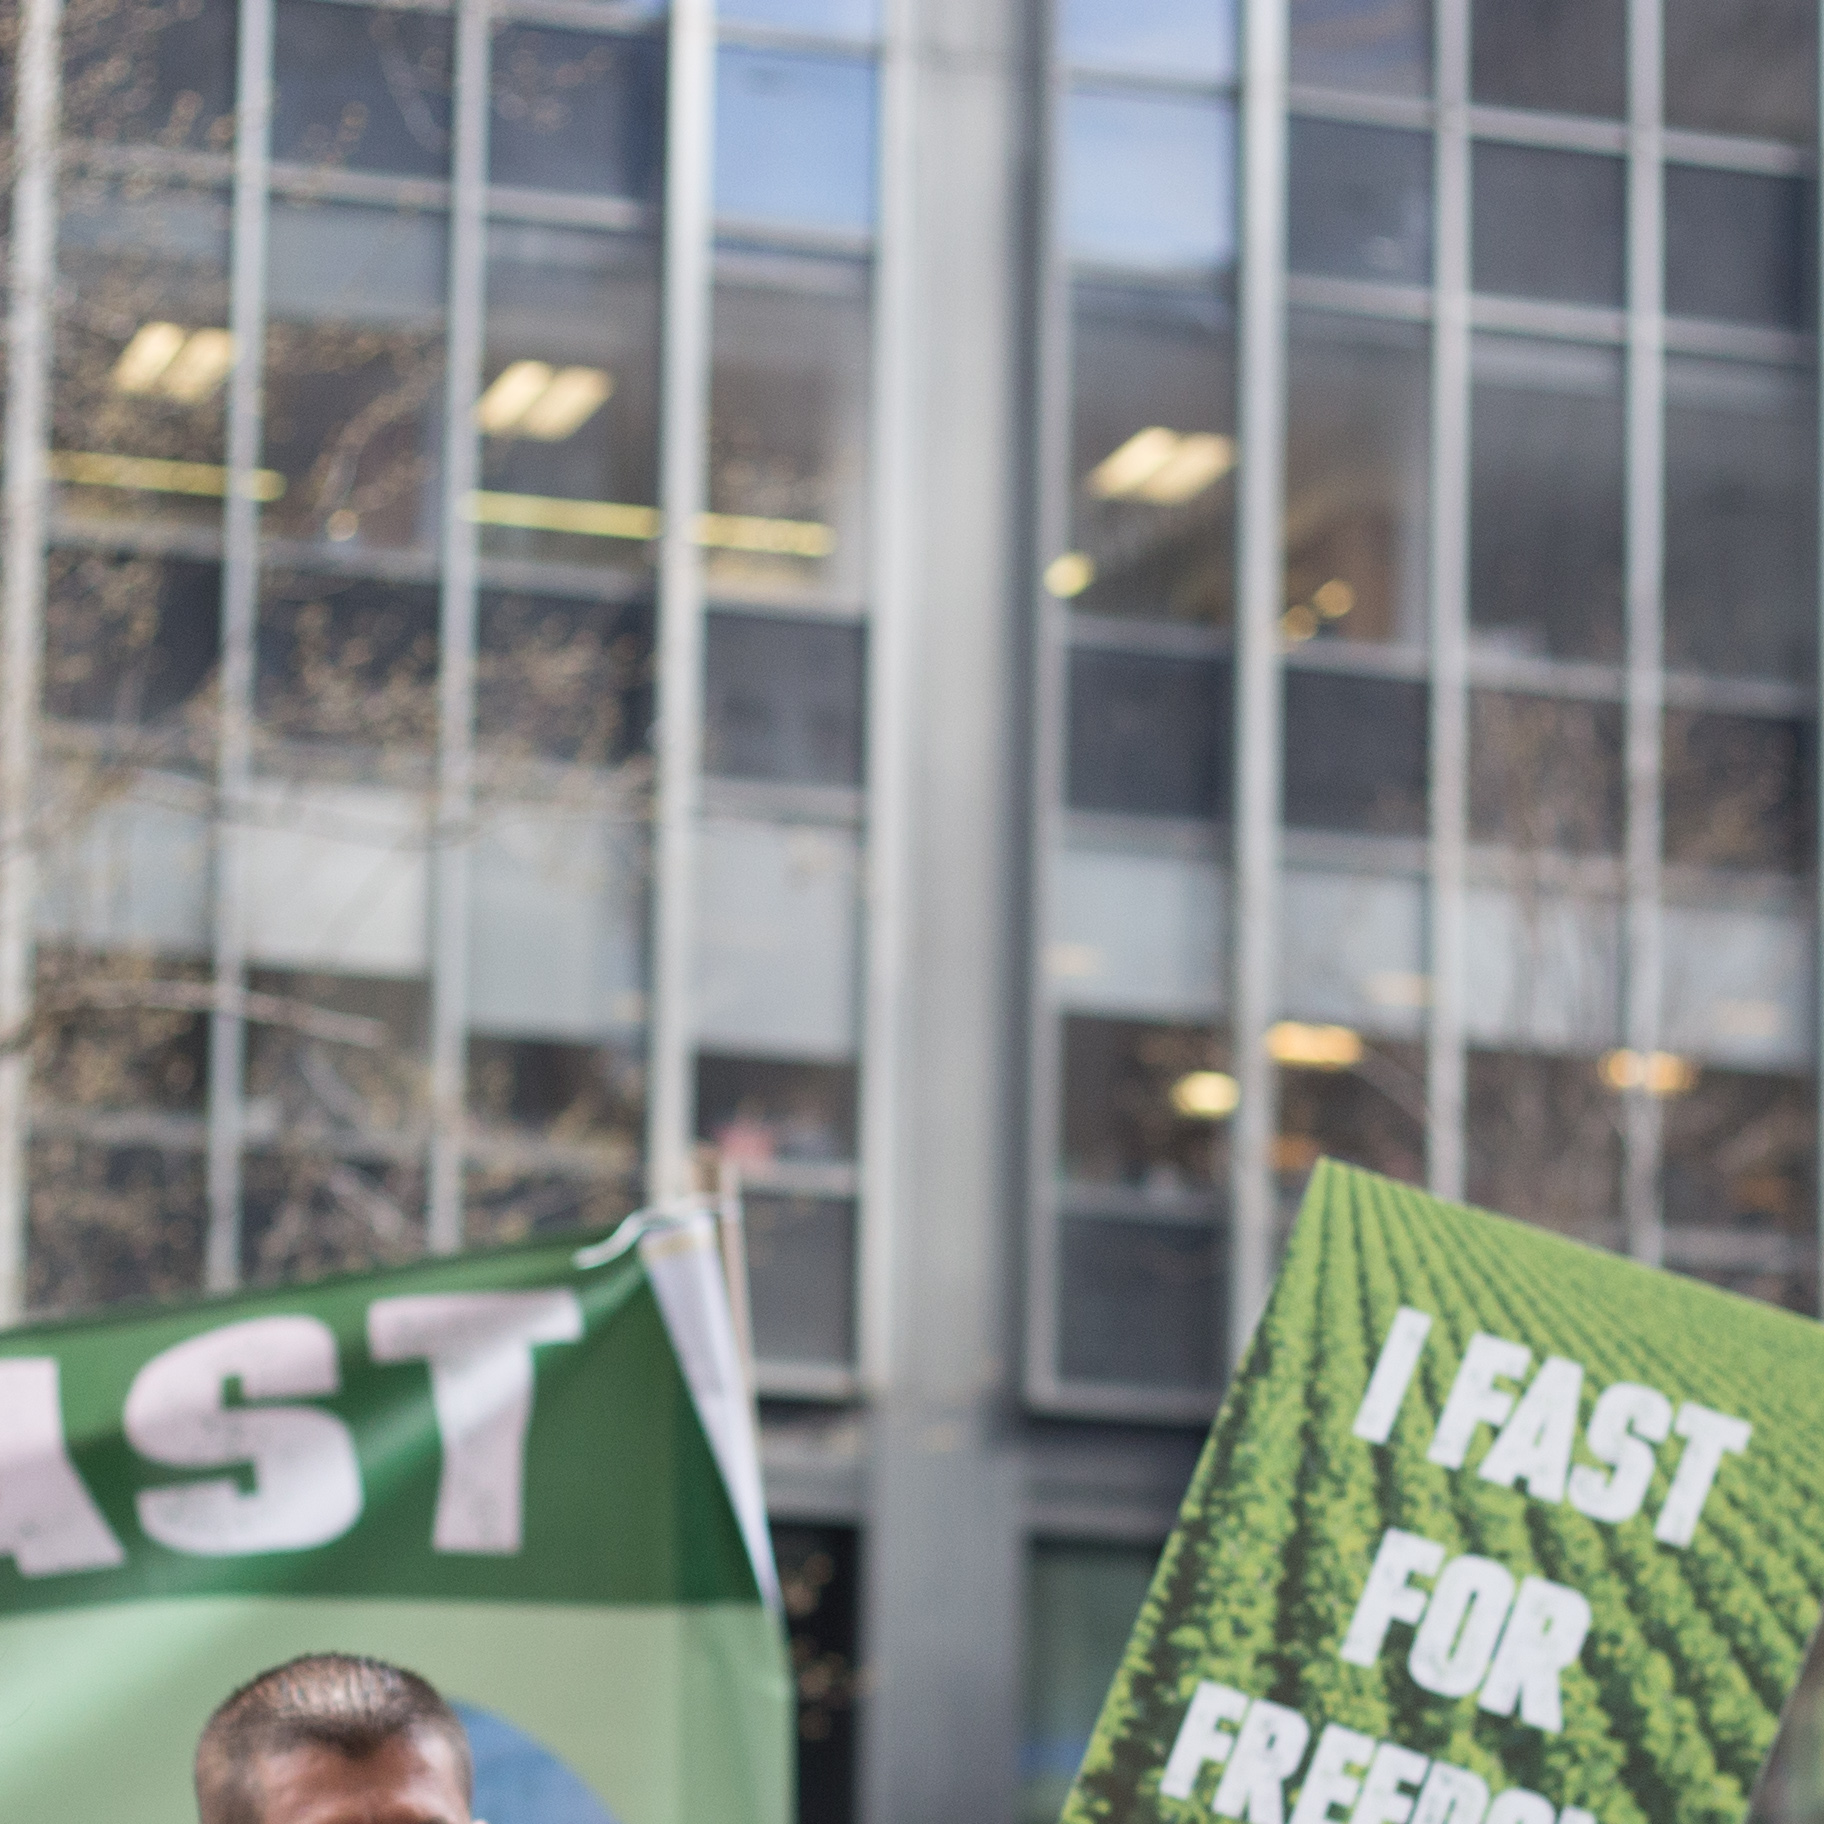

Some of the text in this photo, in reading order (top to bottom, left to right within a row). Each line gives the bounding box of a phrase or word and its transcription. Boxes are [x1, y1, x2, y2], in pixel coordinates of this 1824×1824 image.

[1352, 1304, 1752, 1549] I FAST
[1340, 1526, 1594, 1735] FOR
